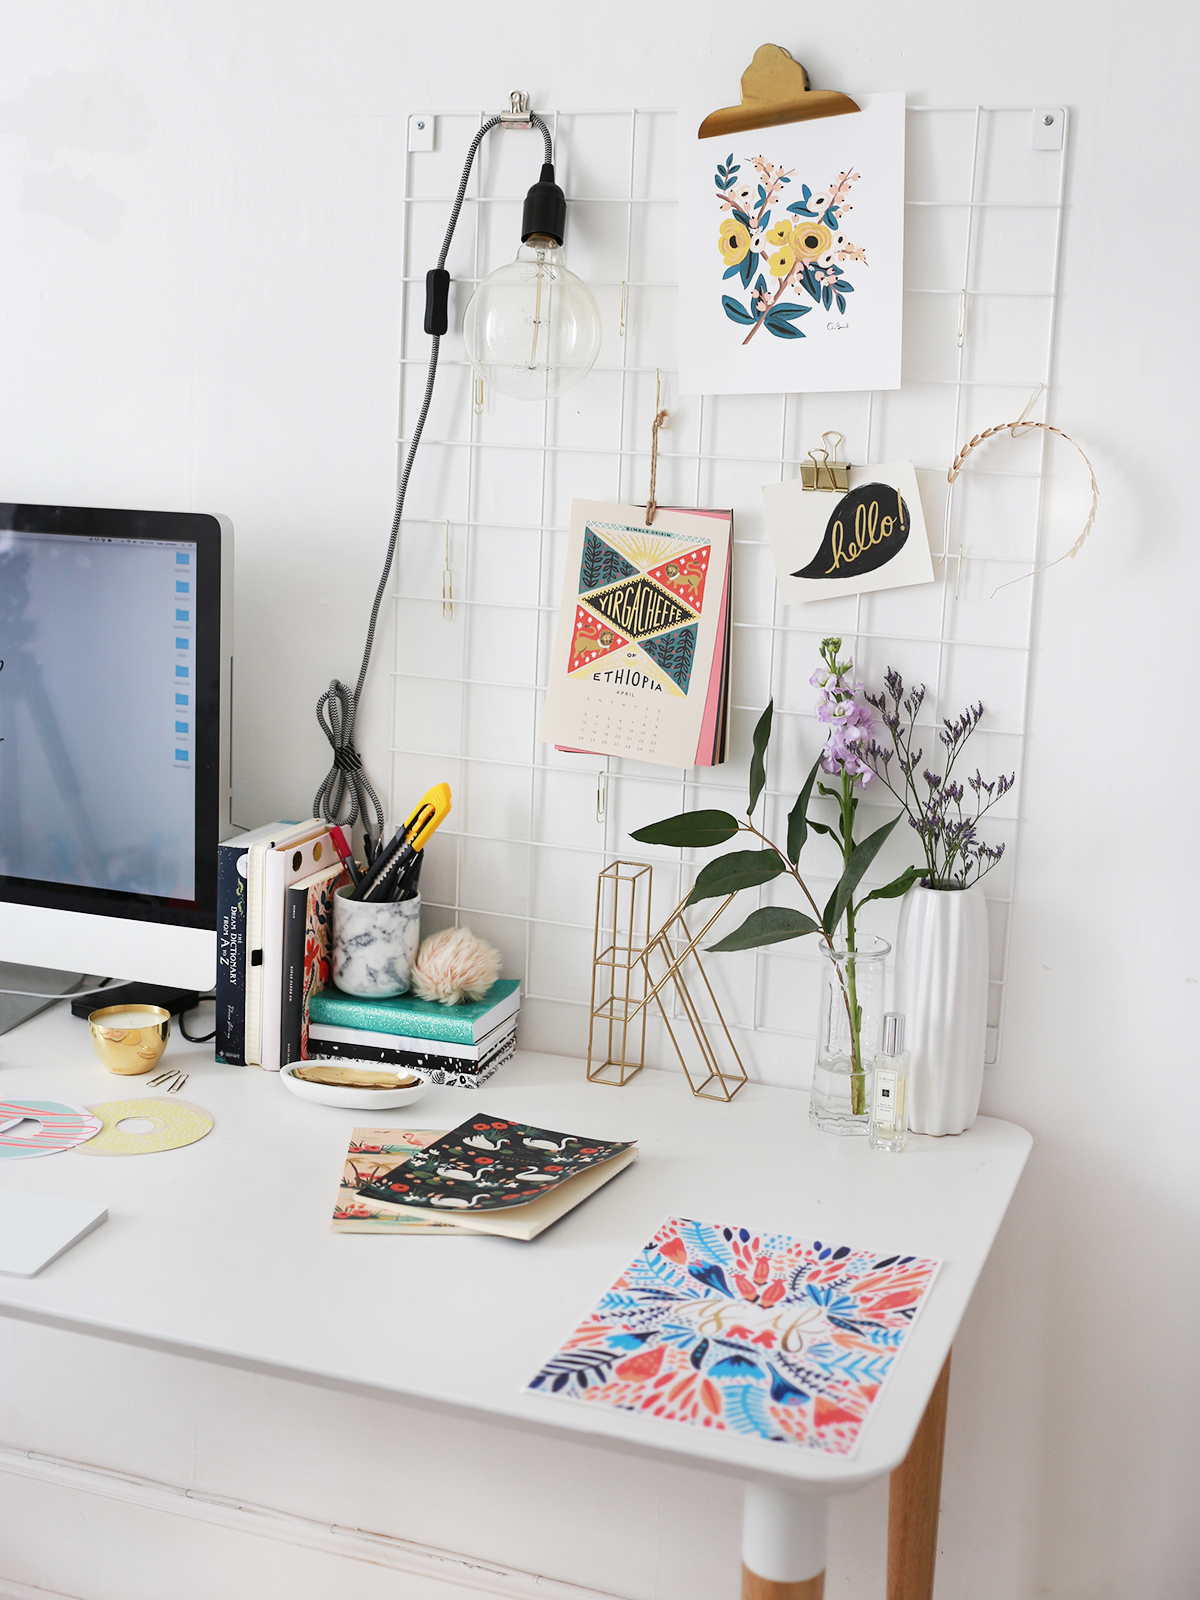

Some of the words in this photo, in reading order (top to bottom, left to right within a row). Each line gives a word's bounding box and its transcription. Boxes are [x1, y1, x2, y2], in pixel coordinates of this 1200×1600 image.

[825, 488, 905, 574] hello!
[599, 583, 683, 634] YIRGACHEFFE
[593, 668, 663, 691] ETHIOPIA
[616, 690, 635, 698] APRIL
[221, 938, 230, 948] A
[220, 956, 229, 965] Z
